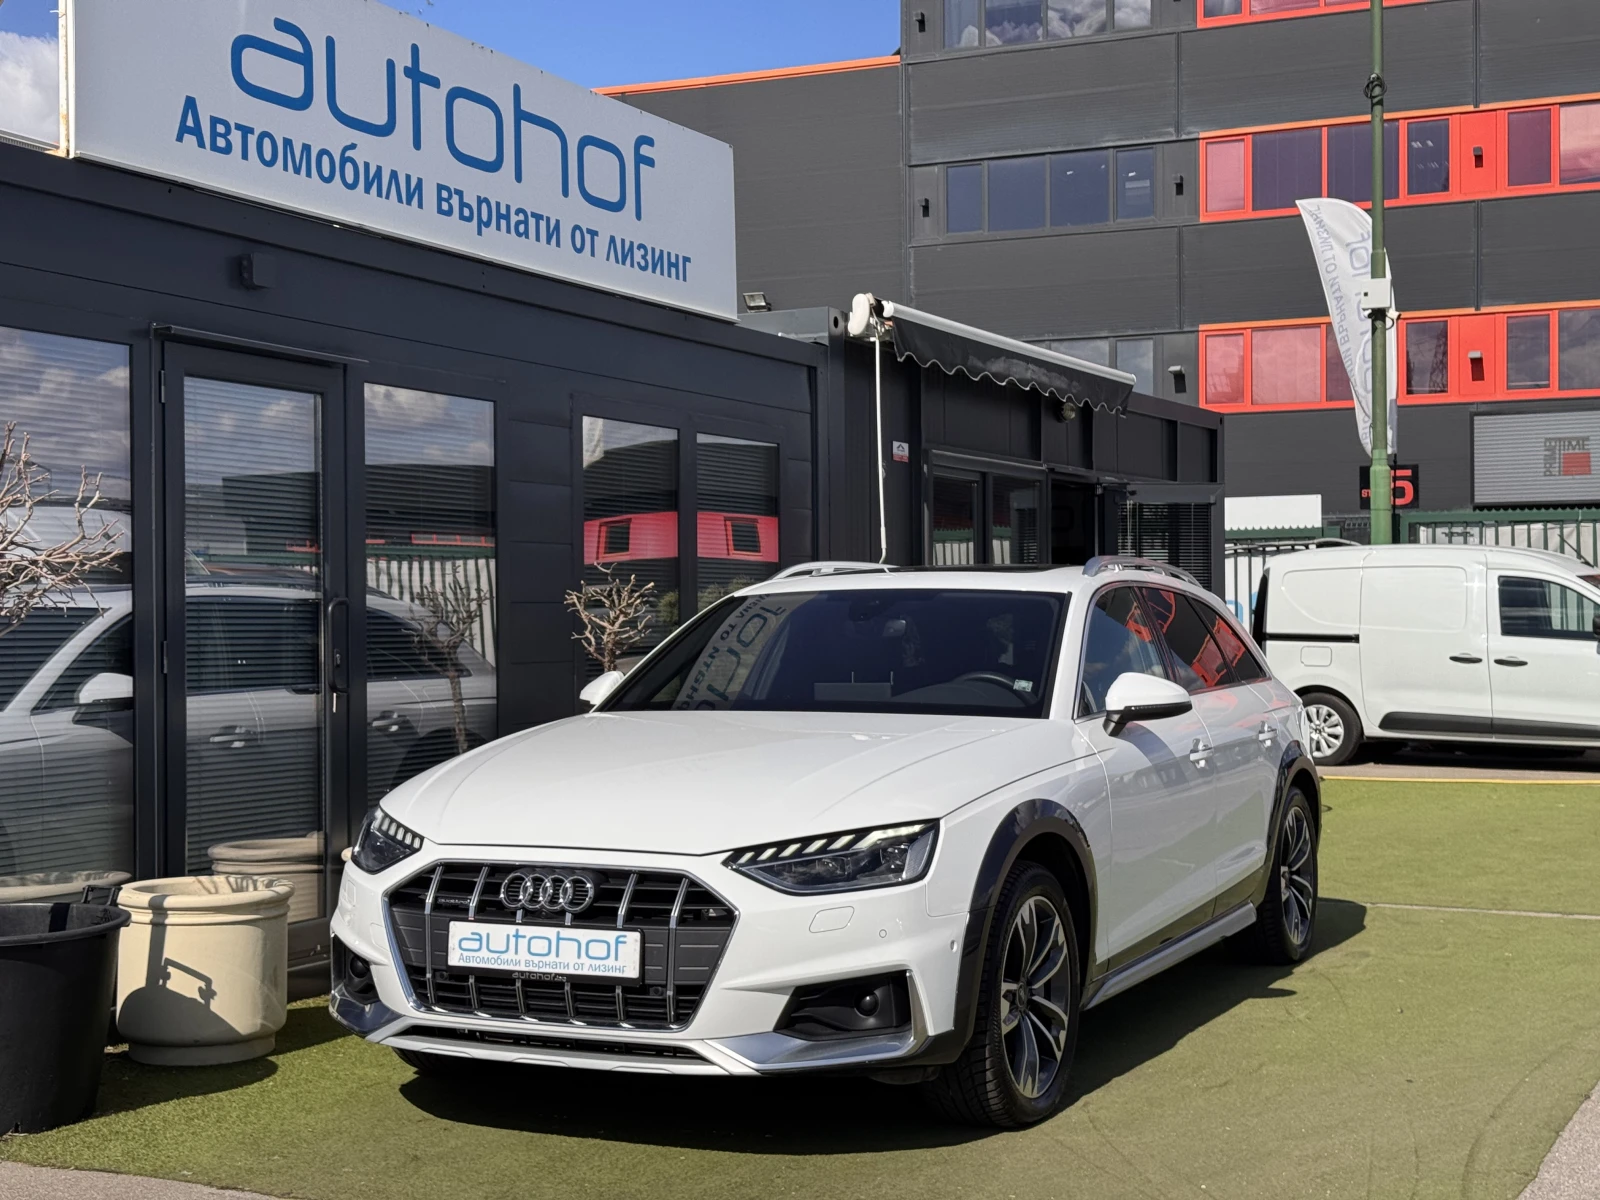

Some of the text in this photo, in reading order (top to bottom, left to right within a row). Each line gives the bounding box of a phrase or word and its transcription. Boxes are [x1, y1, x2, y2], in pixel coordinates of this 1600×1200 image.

[230, 17, 656, 221] autohof
[175, 95, 692, 282] Автомобили върнати от лизинг
[457, 952, 627, 975] Автомобили върнати от лизинг
[458, 928, 627, 961] autohof
